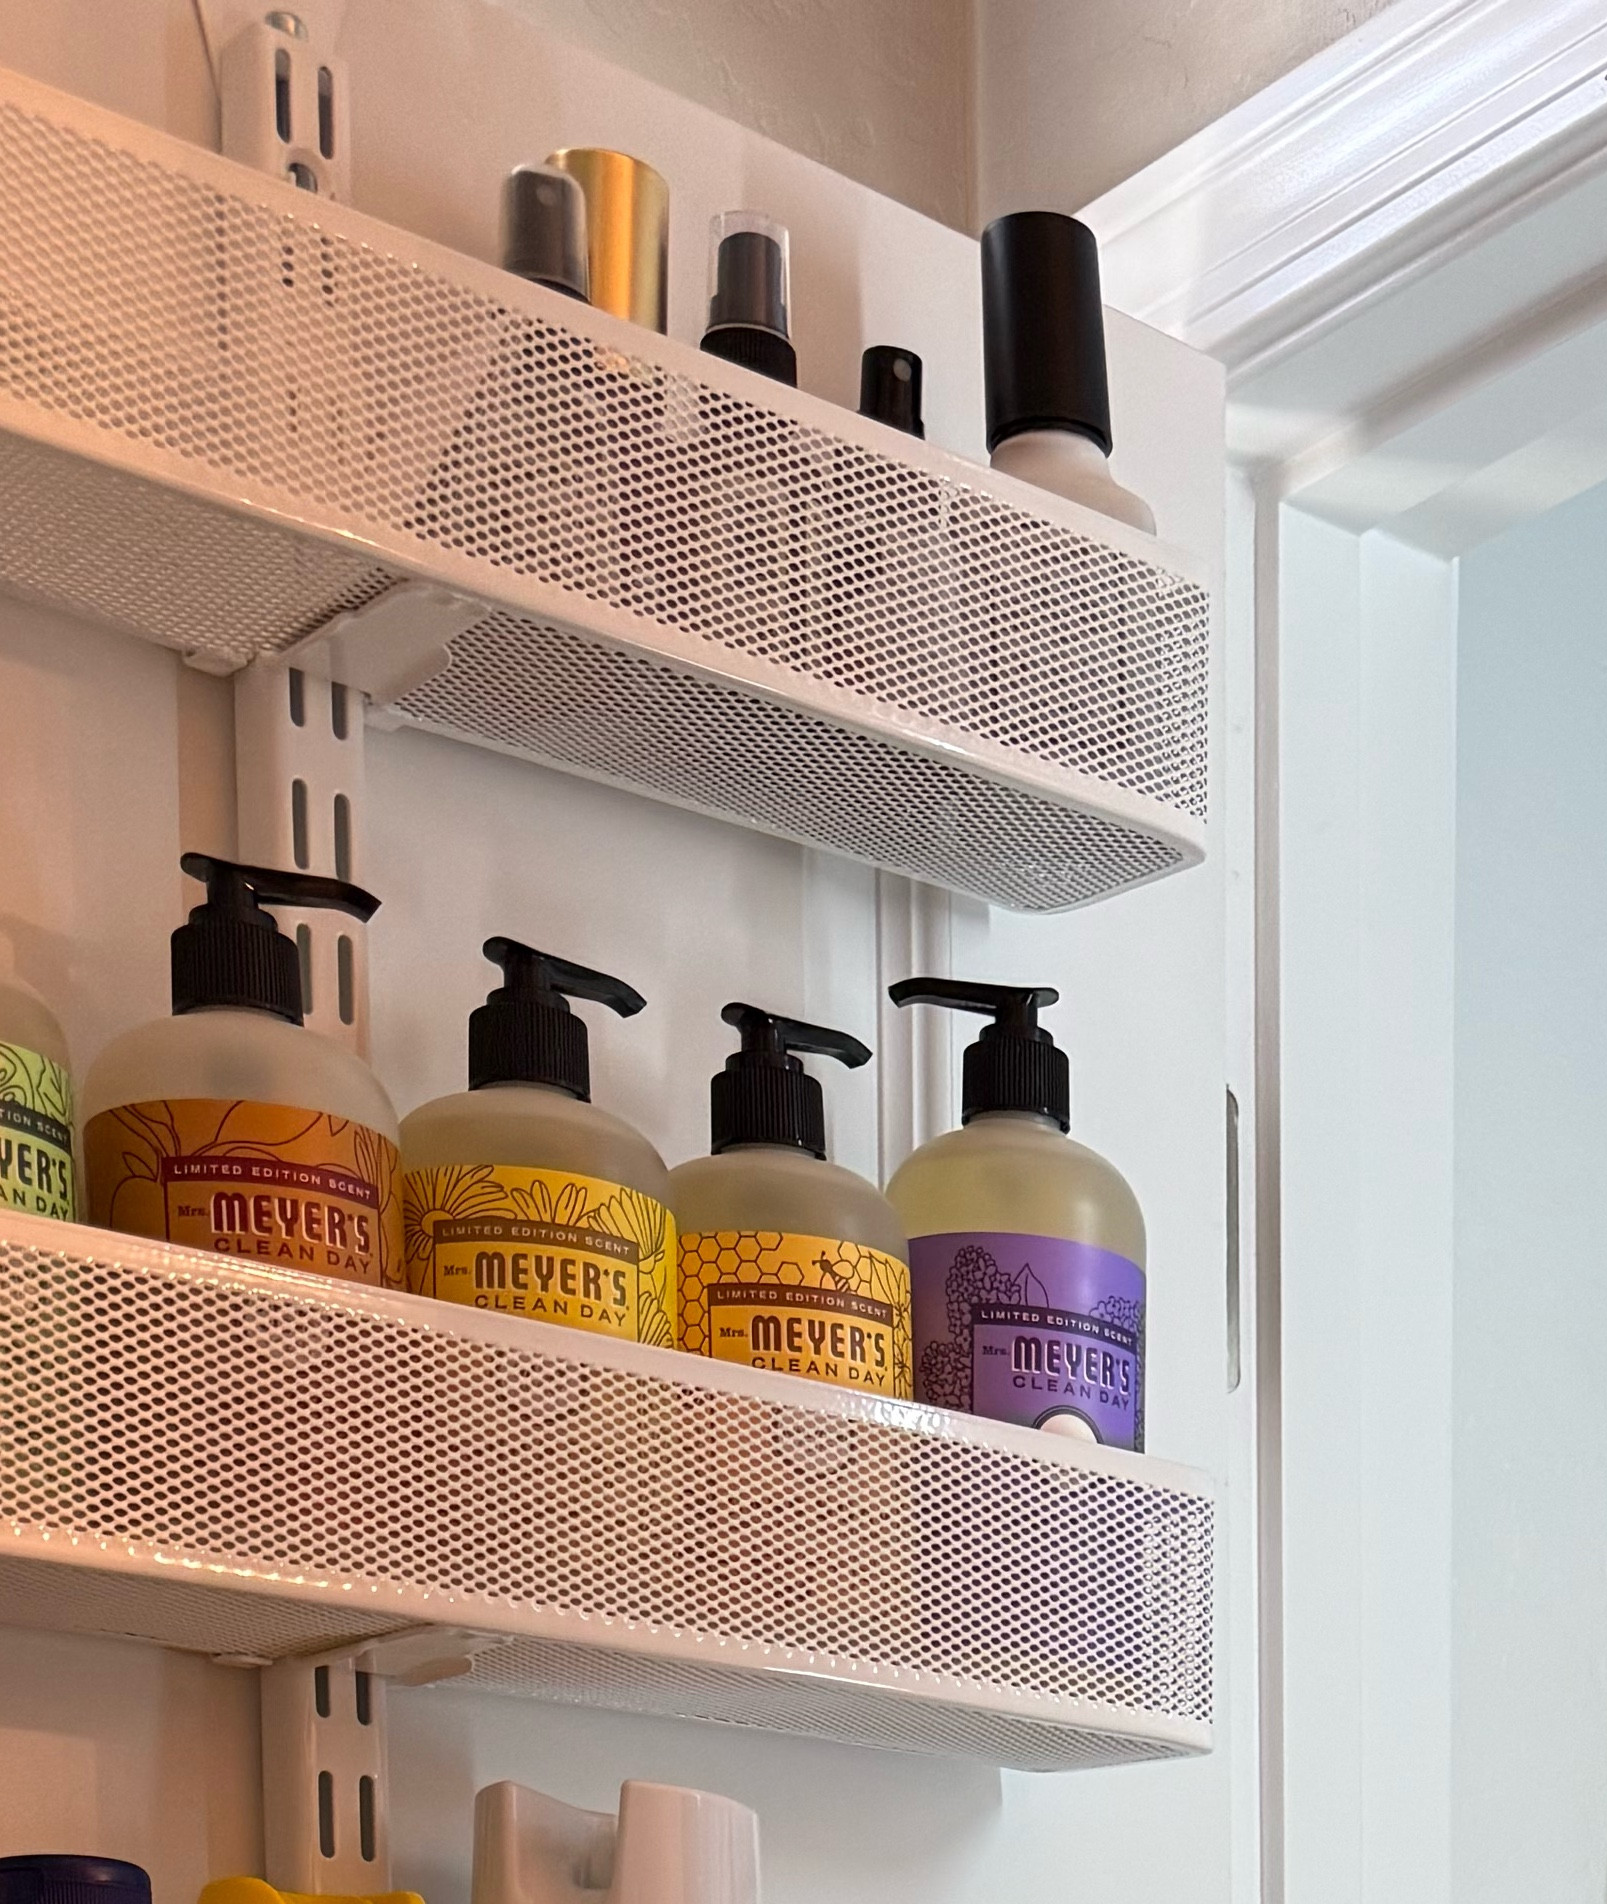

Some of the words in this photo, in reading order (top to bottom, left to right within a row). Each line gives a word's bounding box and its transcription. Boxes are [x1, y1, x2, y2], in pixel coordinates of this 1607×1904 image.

[0, 1110, 31, 1127] TION
[0, 1138, 68, 1201] YER'S
[173, 1164, 242, 1175] LIMITED
[251, 1166, 321, 1185] EDITION
[328, 1178, 371, 1200] SCENT
[36, 1197, 68, 1222] DAY
[210, 1192, 371, 1256] MEYER'S
[214, 1238, 314, 1262] CLEAN
[327, 1251, 371, 1275] DAY
[442, 1226, 503, 1236] LIMITED
[511, 1227, 577, 1242] EDITION
[585, 1236, 629, 1256] SCENT
[475, 1252, 627, 1307] MEYER'S
[475, 1294, 568, 1315] CLEAN
[580, 1305, 626, 1327] DAY
[717, 1290, 778, 1300] LIMITED
[786, 1292, 845, 1307] EDITION
[851, 1301, 887, 1318] SCENT
[719, 1327, 748, 1338] Mrs.
[752, 1315, 886, 1368] MEYER'S
[981, 1310, 1039, 1322] LIMITED
[1047, 1315, 1099, 1333] EDITION
[1104, 1328, 1132, 1345] SCENT
[751, 1356, 838, 1377] CLEAN
[849, 1367, 886, 1387] DAY
[1011, 1335, 1130, 1395] MEYER'S
[1012, 1375, 1091, 1399] CLEAN
[1099, 1390, 1130, 1410] DAY
